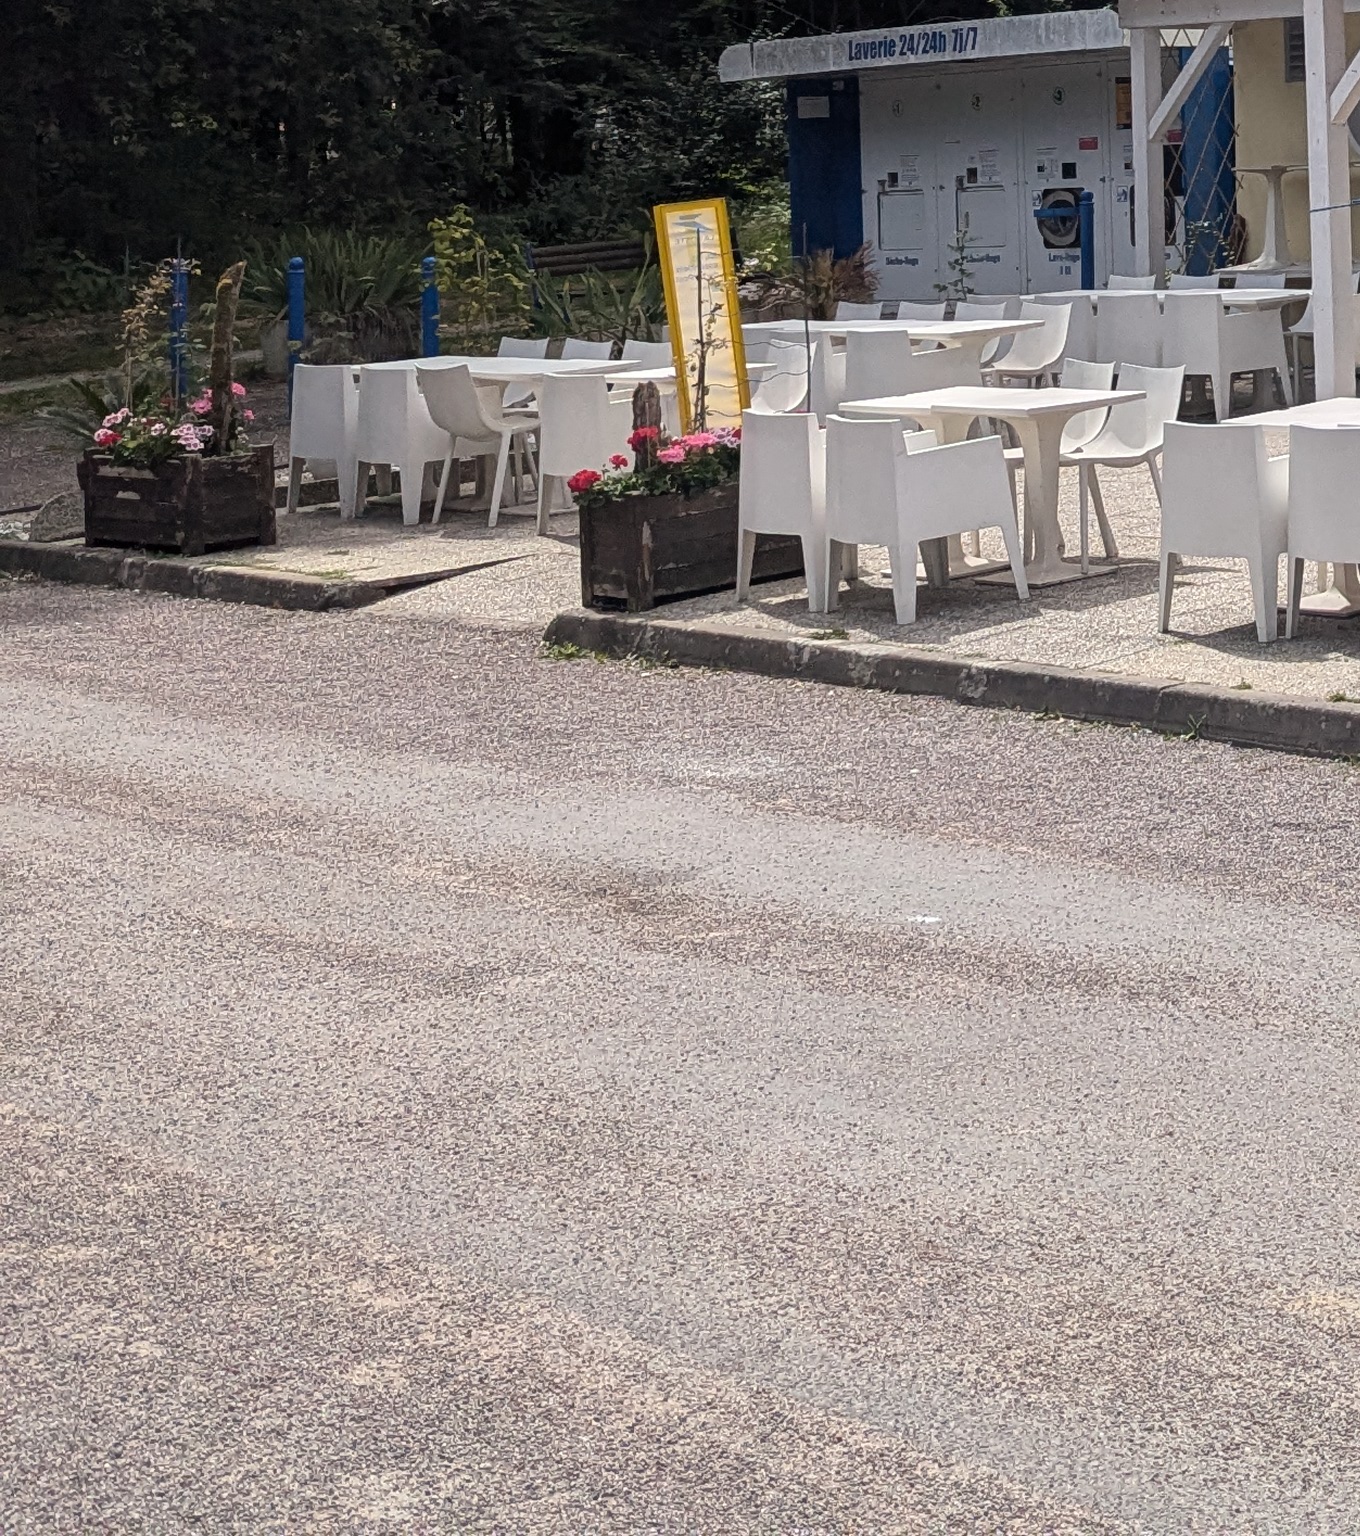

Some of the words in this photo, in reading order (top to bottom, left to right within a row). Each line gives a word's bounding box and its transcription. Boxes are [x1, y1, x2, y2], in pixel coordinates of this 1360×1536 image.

[848, 35, 897, 62] Laverie
[898, 30, 947, 57] 24/24h
[951, 26, 978, 54] 7j/7
